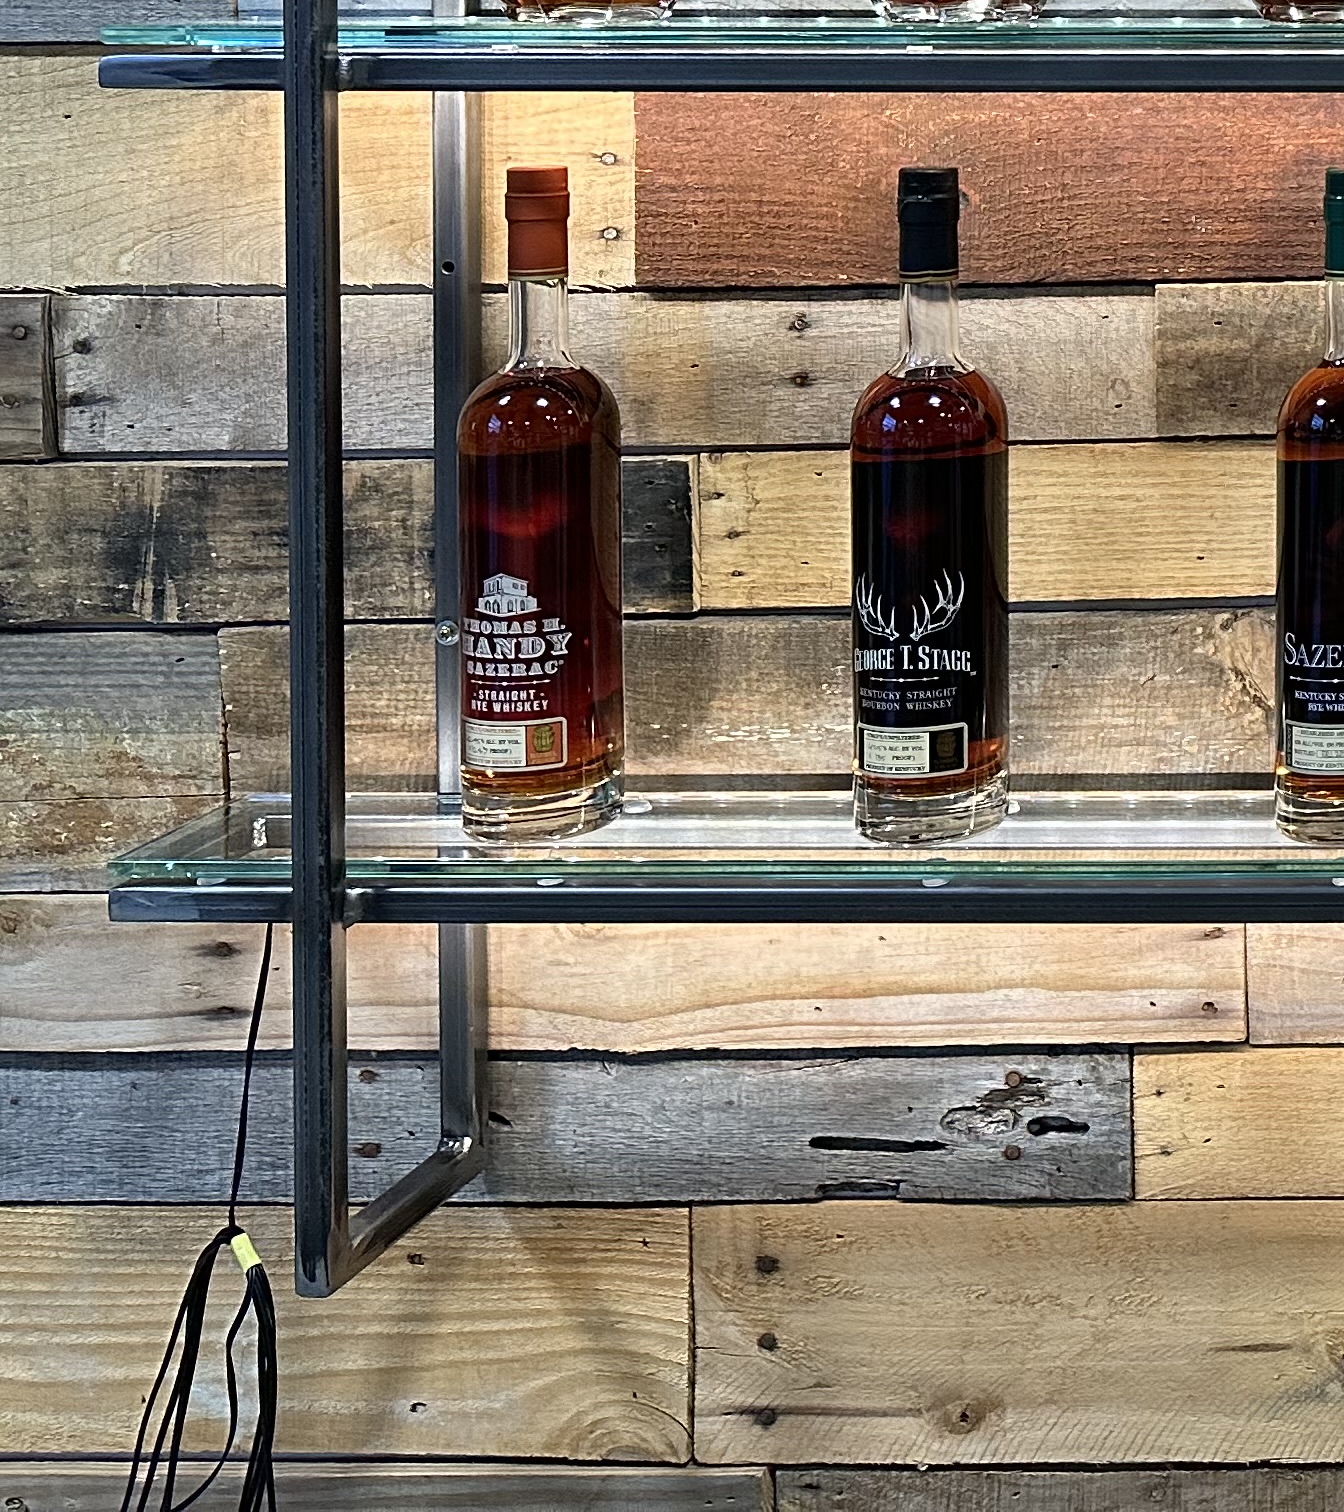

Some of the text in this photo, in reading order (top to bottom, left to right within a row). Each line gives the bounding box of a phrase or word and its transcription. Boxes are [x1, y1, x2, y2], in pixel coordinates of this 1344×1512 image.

[463, 617, 567, 635] THOMAS H.
[462, 632, 572, 660] HANDY
[854, 645, 971, 673] GEORGE T. STAGG
[466, 660, 560, 677] SAZERAC
[478, 689, 536, 702] STRAIGHT
[860, 687, 957, 701] KENTUCKY STRAIGHT
[1294, 690, 1337, 701] KENTUCKY
[471, 700, 549, 712] RYE WHISKEY
[862, 697, 953, 711] BOURBON WHISKEY
[1308, 702, 1325, 711] RYE
